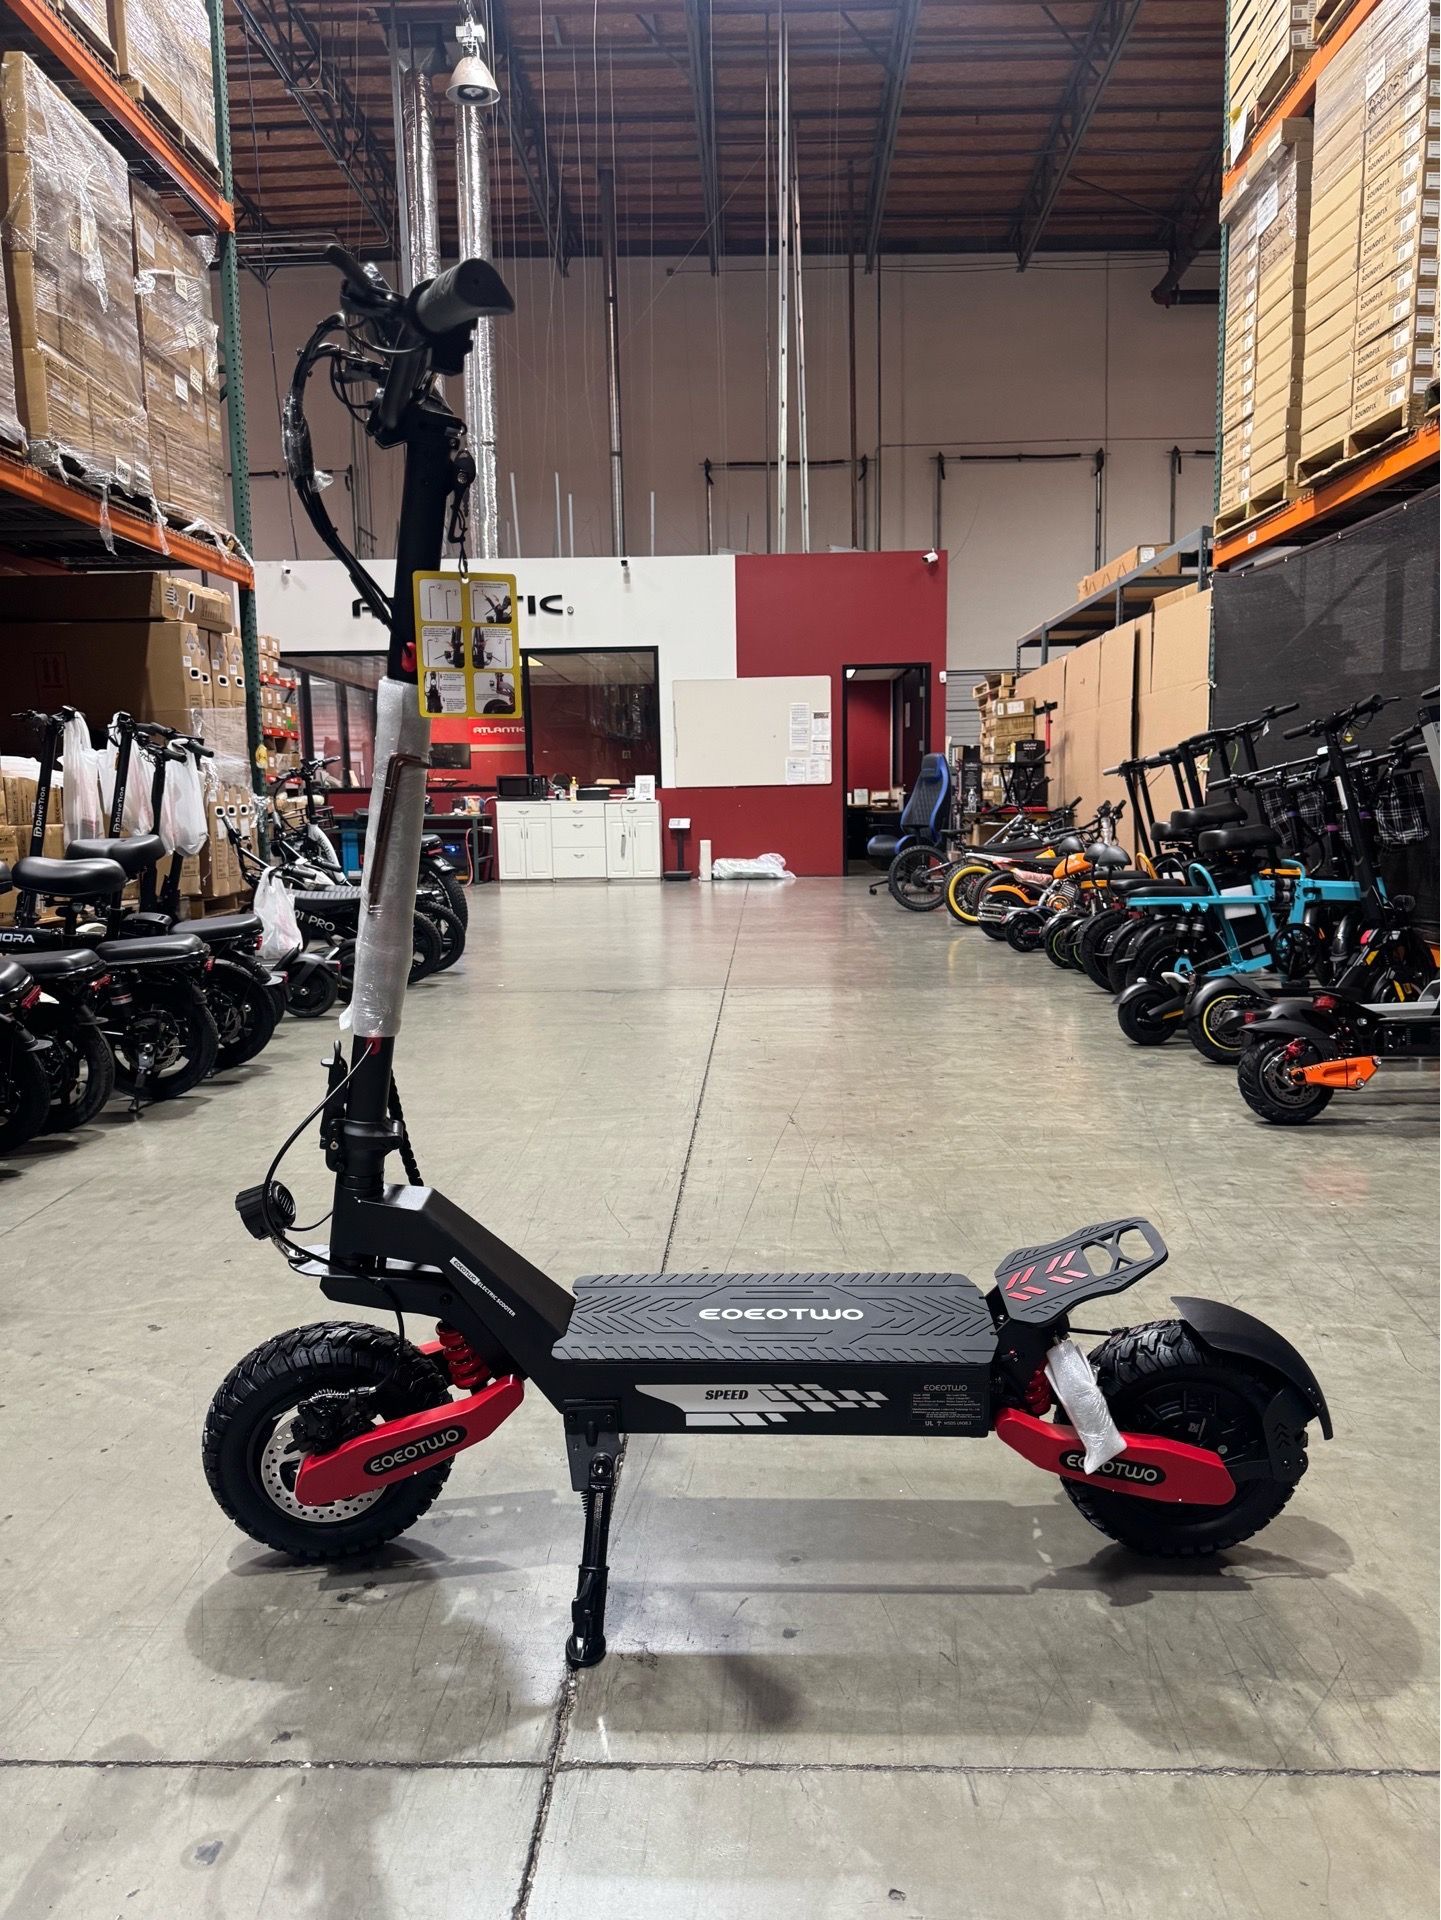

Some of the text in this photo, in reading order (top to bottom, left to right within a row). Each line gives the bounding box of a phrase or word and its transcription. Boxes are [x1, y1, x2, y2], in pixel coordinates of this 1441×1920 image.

[308, 915, 336, 932] PRO
[477, 1281, 498, 1301] ELECTRIC
[496, 1298, 516, 1317] SCOOTER
[698, 1308, 864, 1321] EOEOTWO
[704, 1389, 749, 1401] SPEED
[370, 1429, 459, 1472] EOEOTWO
